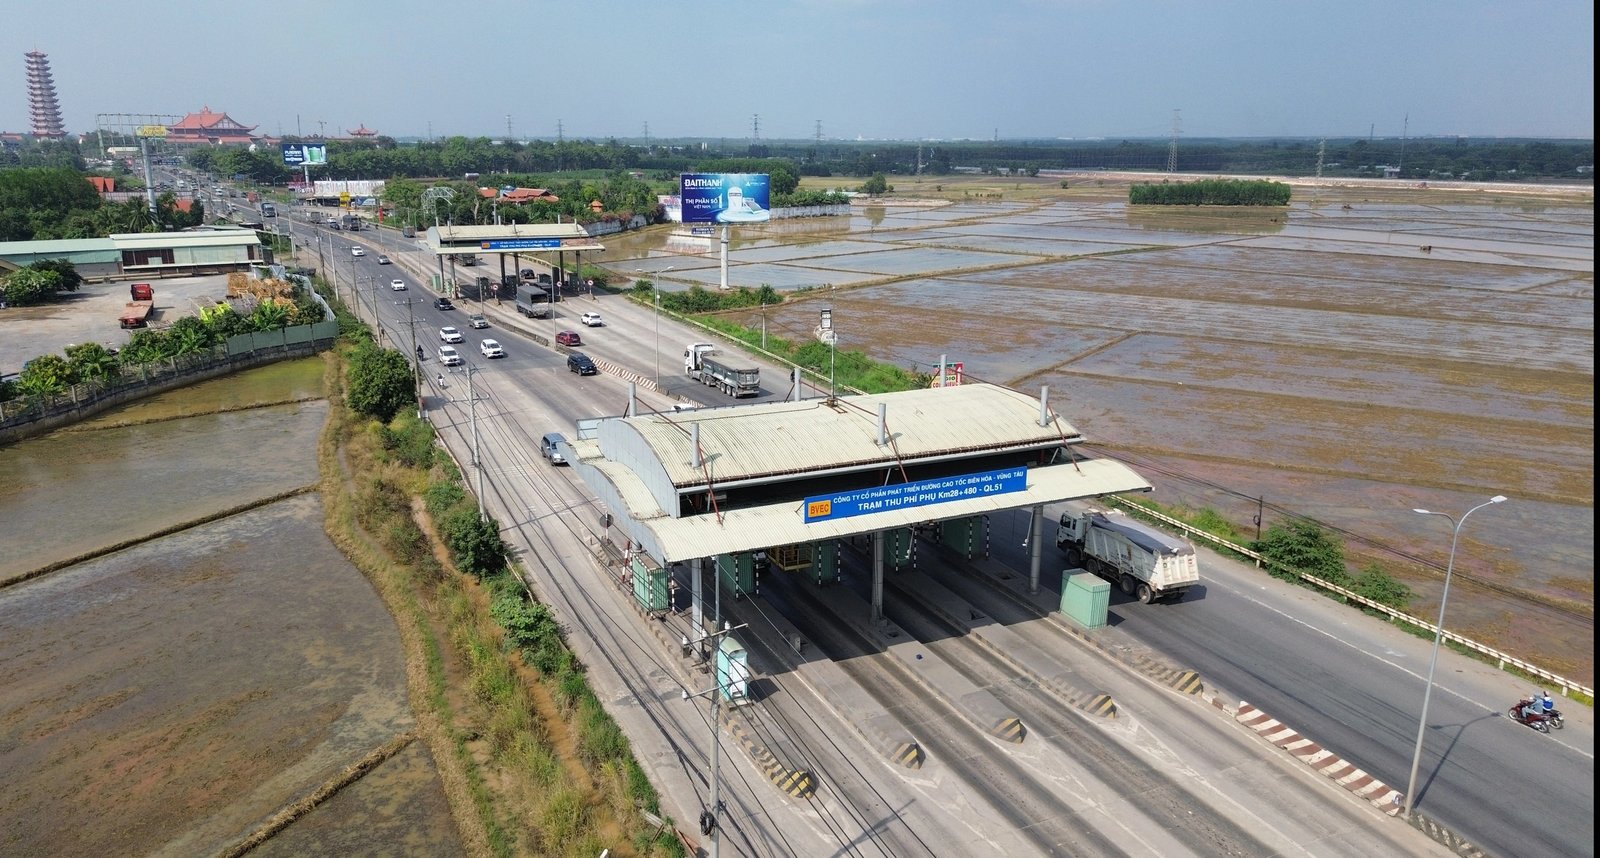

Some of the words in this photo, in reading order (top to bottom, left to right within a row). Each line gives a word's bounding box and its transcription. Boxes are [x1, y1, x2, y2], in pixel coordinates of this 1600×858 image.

[718, 193, 722, 208] 1
[833, 495, 851, 504] CÔNG
[887, 487, 902, 496] PHÁT
[903, 484, 921, 494] TRIỂN
[921, 481, 941, 491] ĐƯỜNG
[942, 480, 954, 488] CAO
[955, 477, 967, 486] TỐC
[967, 476, 980, 485] BIÊN
[980, 474, 992, 482] HÒA
[996, 472, 1012, 480] VŨNG
[1013, 470, 1024, 478] TÀU
[858, 501, 882, 511] TRẠM
[884, 498, 902, 507] THU
[903, 493, 918, 504] PHÍ
[919, 492, 936, 502] PHỤ
[938, 486, 978, 499] Km28+480
[983, 483, 1003, 492] QL51
[810, 503, 829, 515] BVEC
